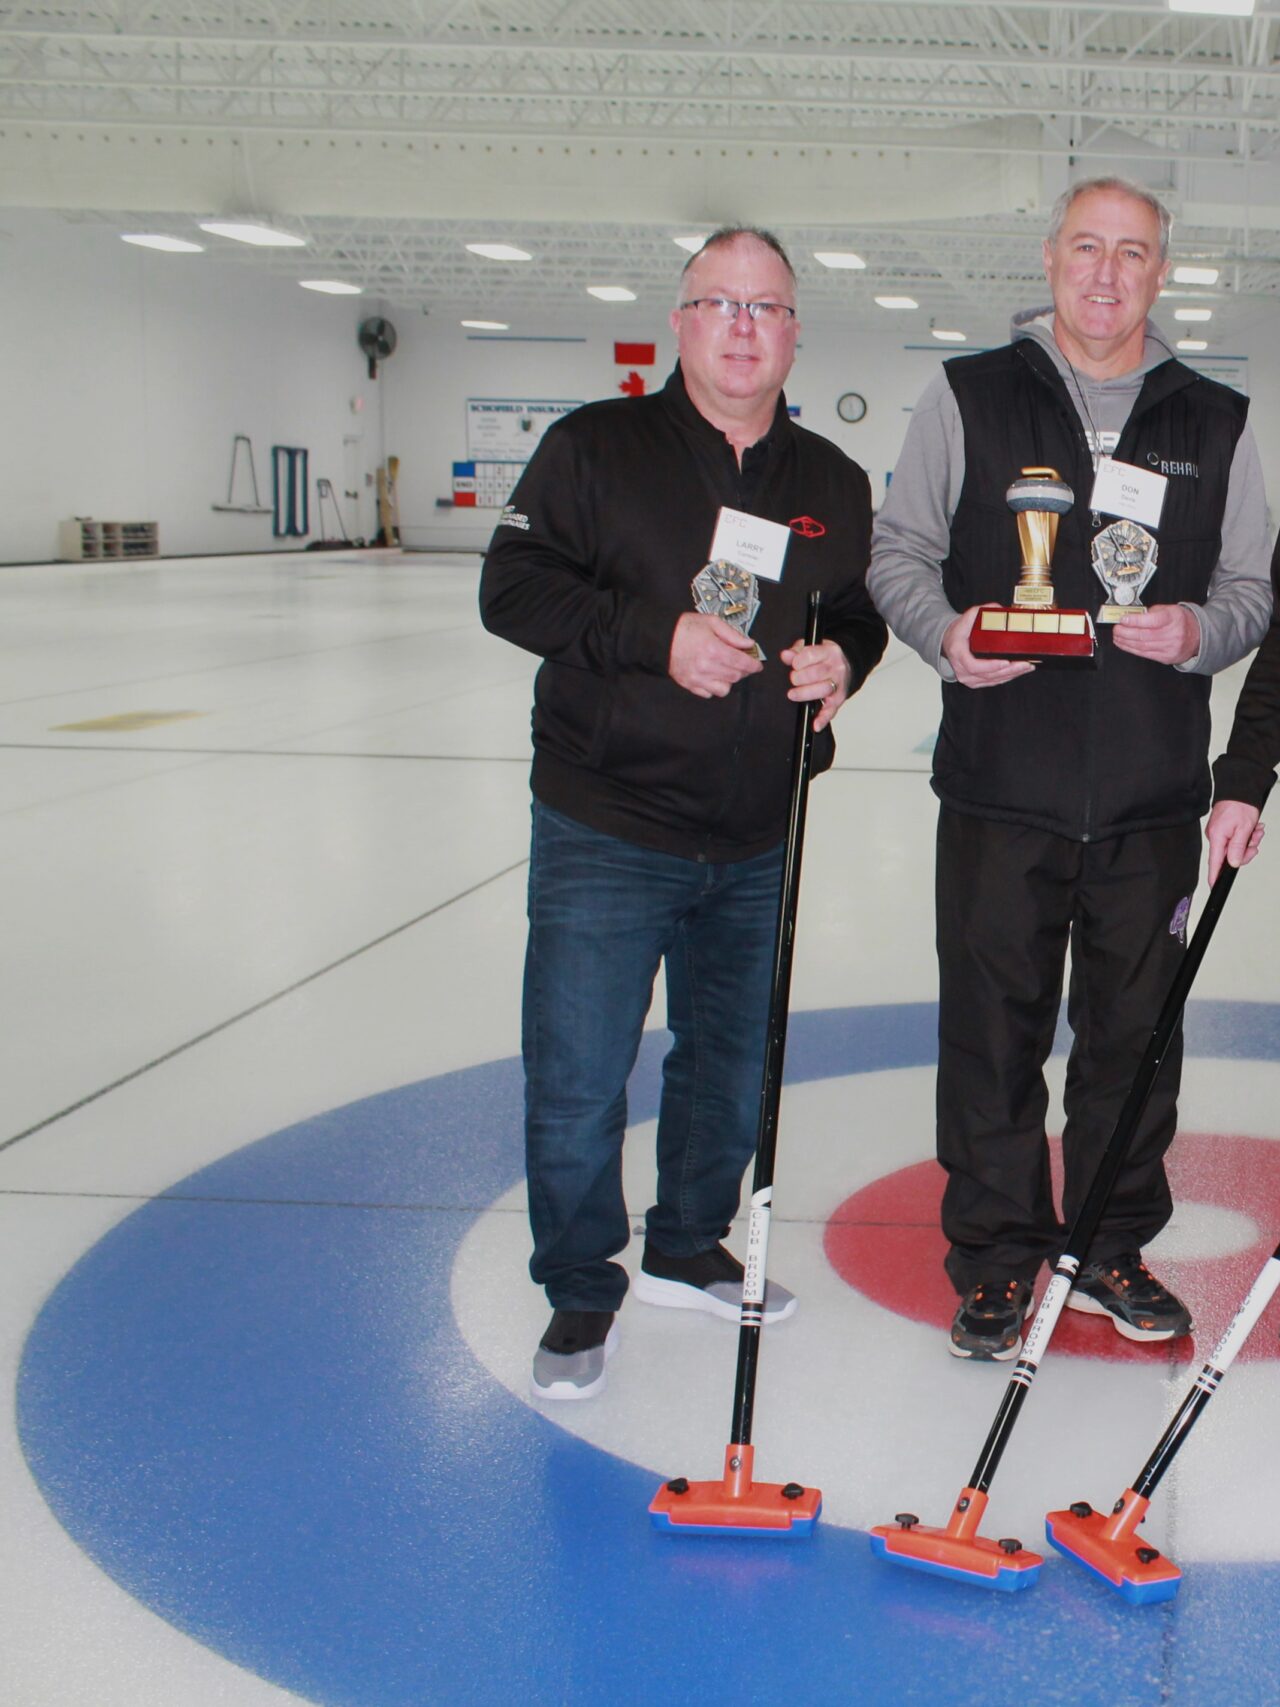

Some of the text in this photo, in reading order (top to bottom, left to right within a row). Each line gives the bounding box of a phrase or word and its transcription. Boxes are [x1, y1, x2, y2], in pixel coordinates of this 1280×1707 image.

[1160, 460, 1200, 479] REHAU
[1121, 484, 1140, 496] DON
[735, 539, 766, 553] LARRY
[750, 1211, 762, 1245] CLUB
[744, 1254, 759, 1297] BROOM
[1041, 1280, 1060, 1310] CLUB
[1021, 1316, 1044, 1356] BROOM
